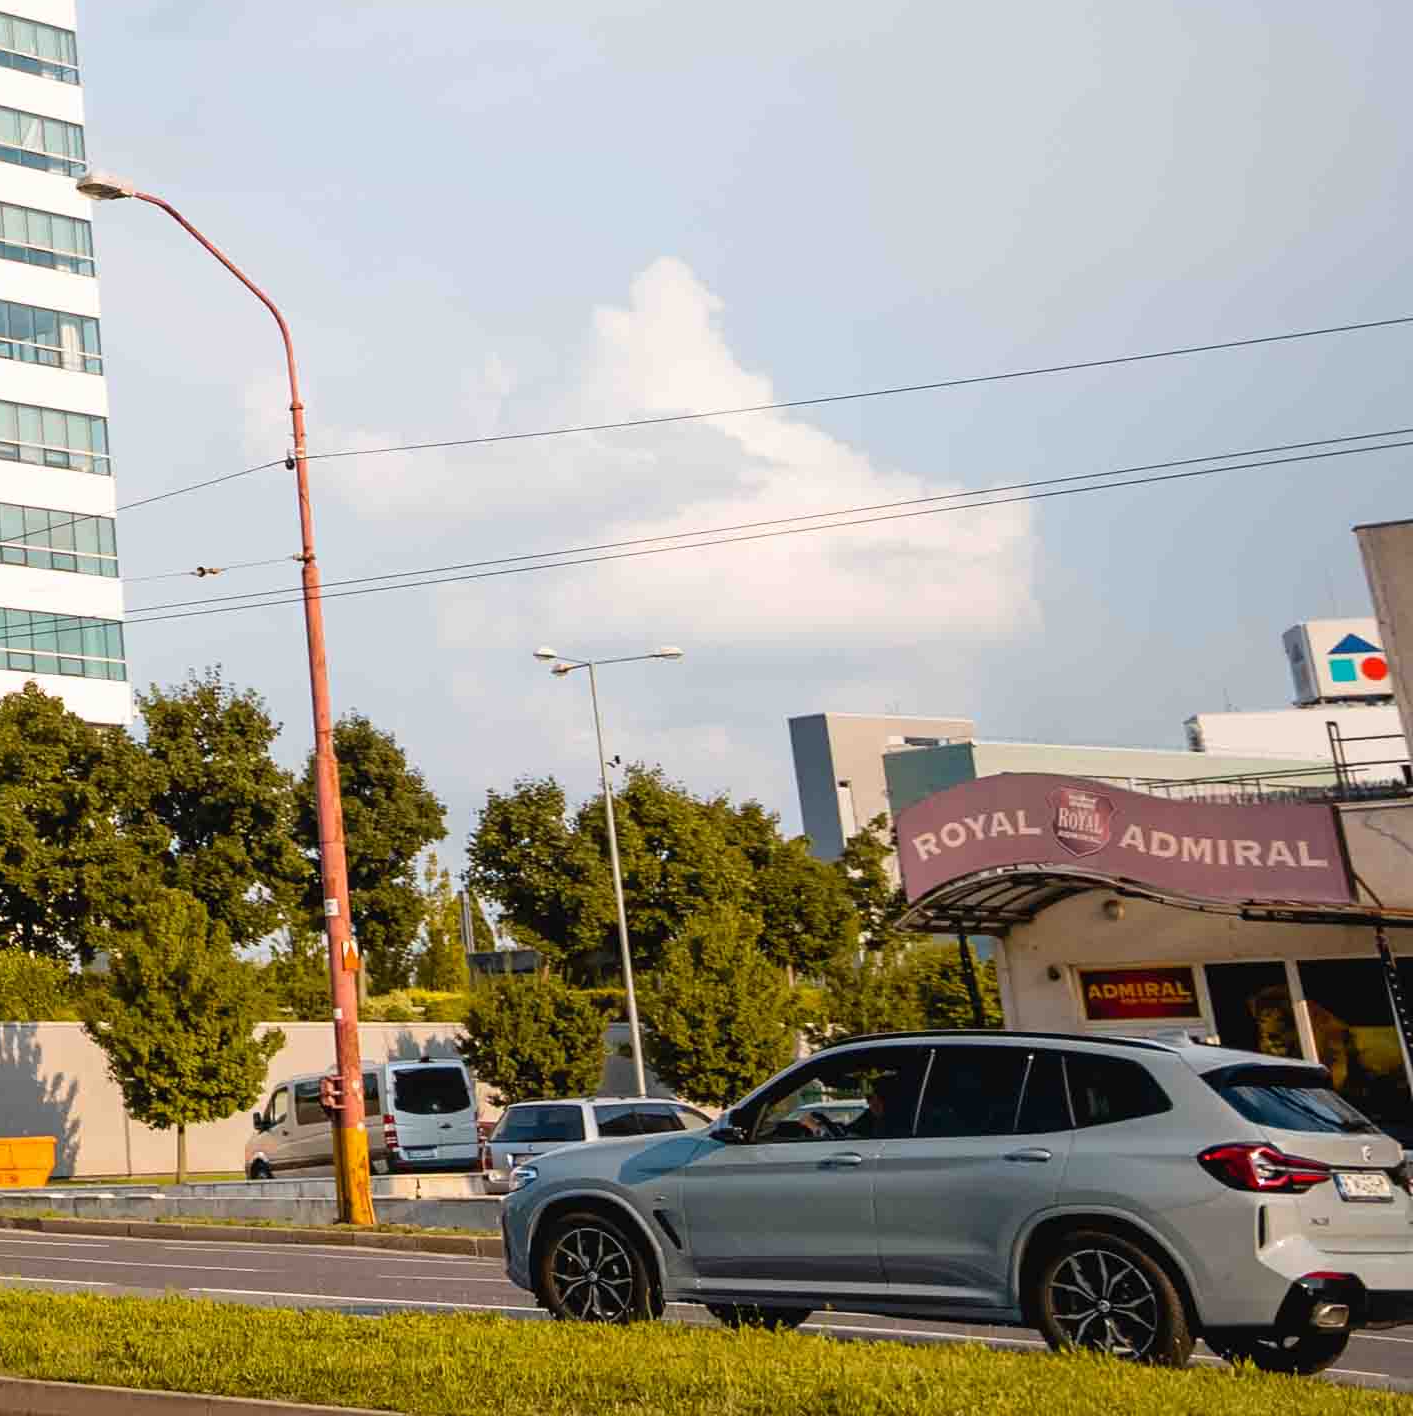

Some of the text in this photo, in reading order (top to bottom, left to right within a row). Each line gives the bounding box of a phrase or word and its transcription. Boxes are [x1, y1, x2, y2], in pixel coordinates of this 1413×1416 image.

[911, 809, 1329, 868] ROYAL ADMIRAL
[1089, 981, 1192, 1000] ADMIRAL
